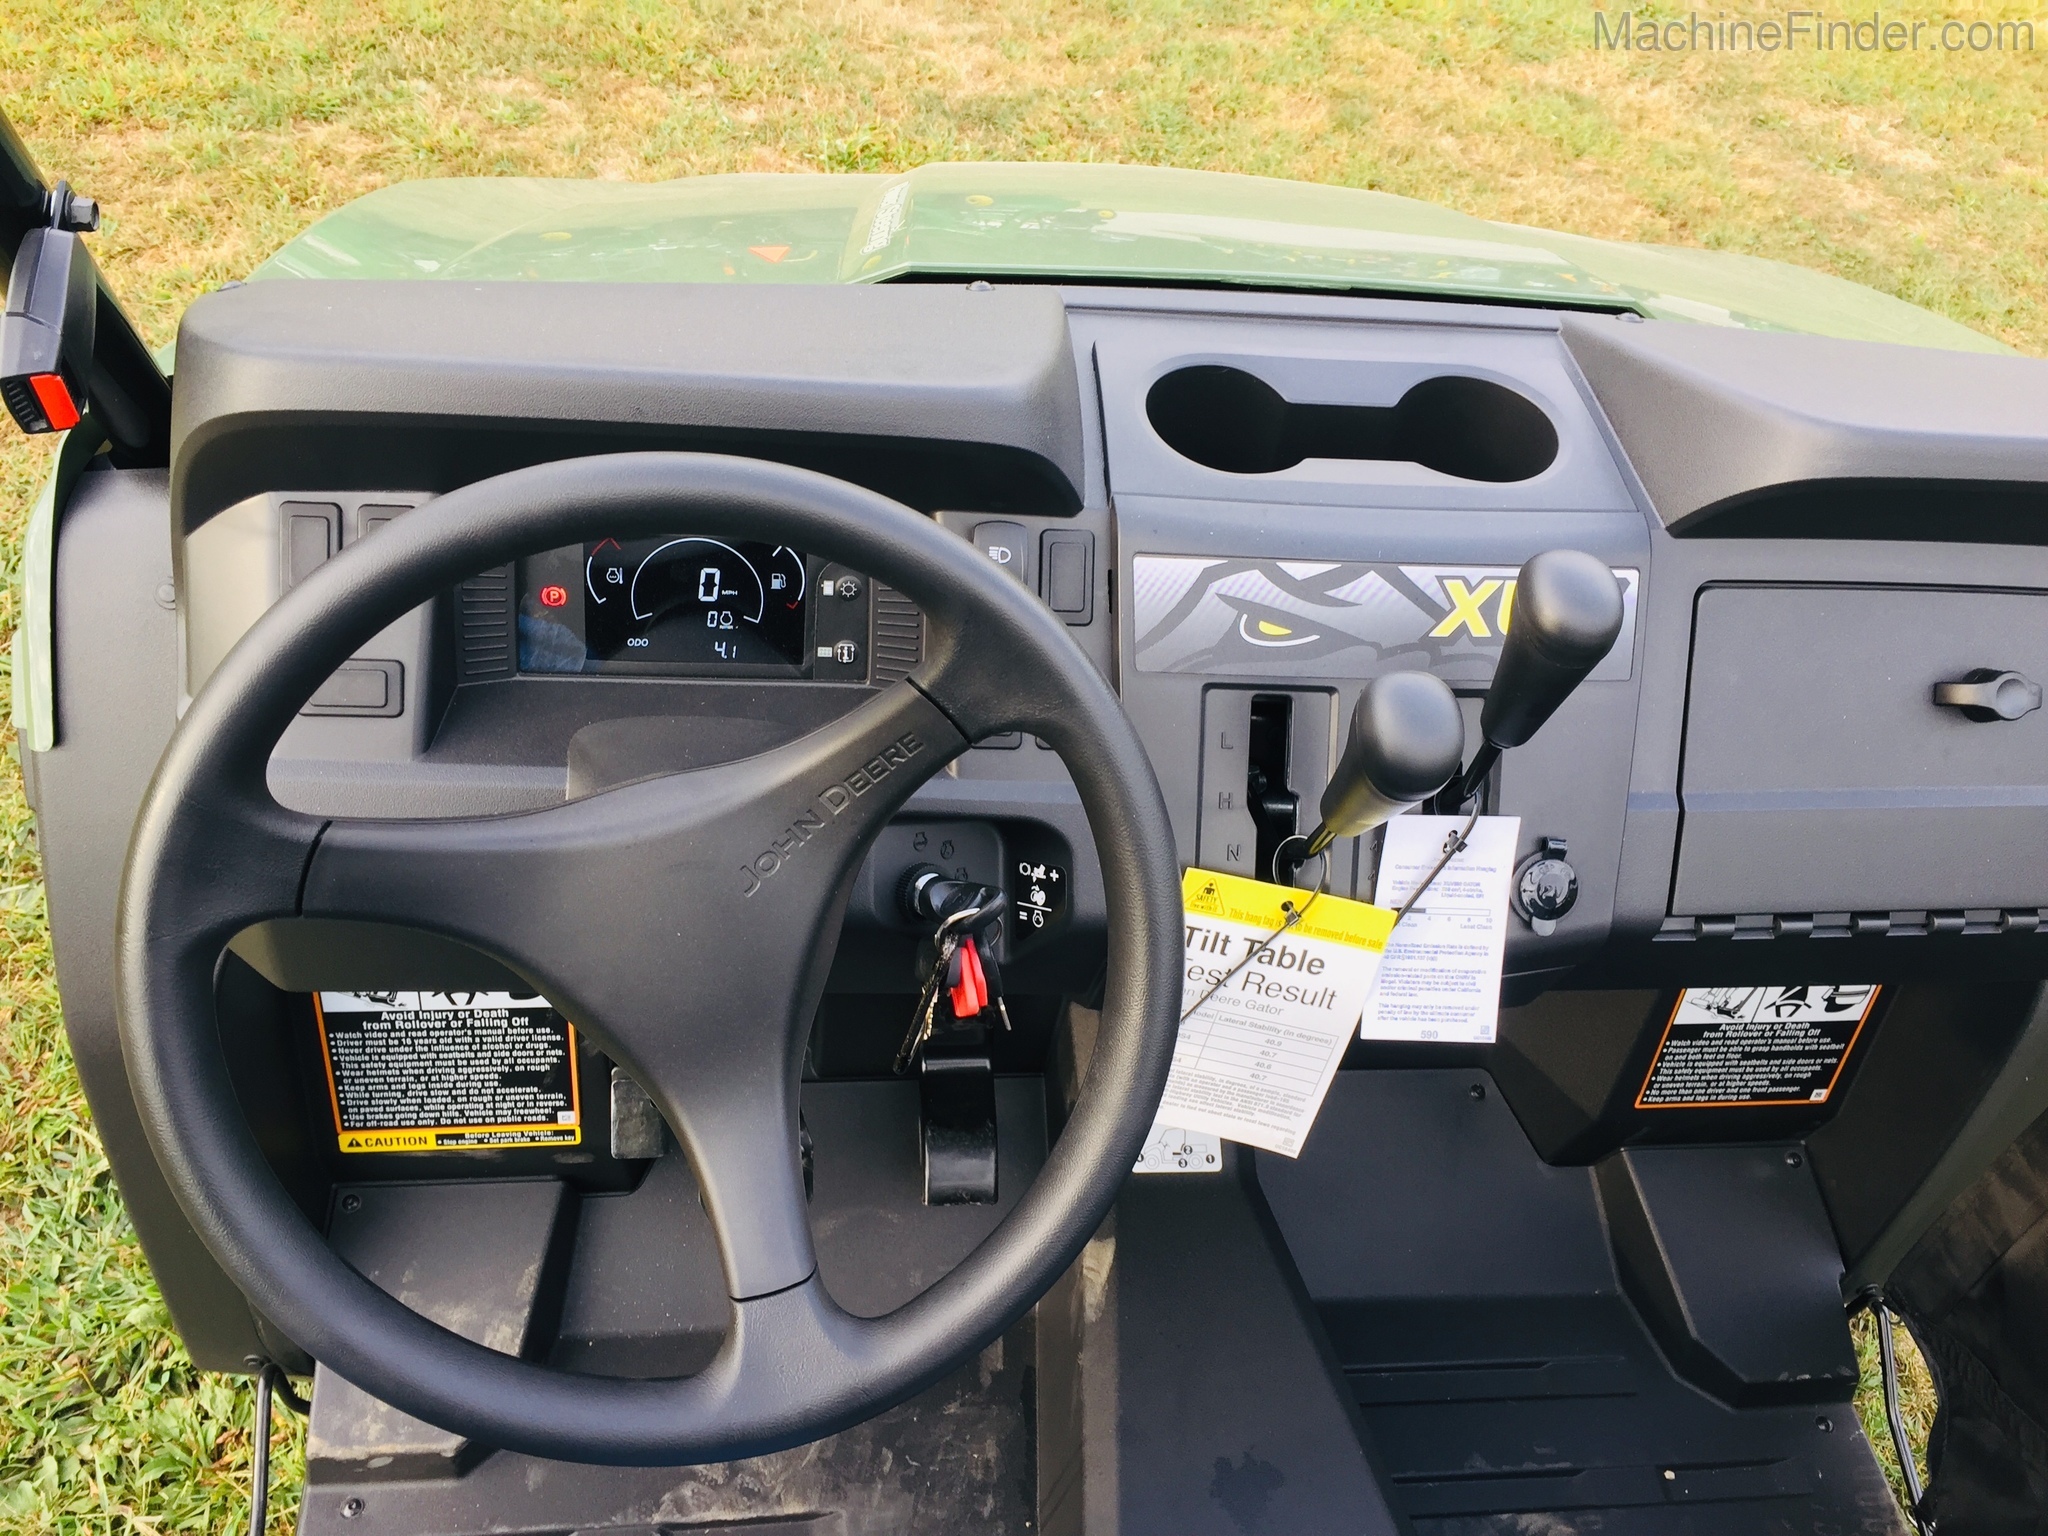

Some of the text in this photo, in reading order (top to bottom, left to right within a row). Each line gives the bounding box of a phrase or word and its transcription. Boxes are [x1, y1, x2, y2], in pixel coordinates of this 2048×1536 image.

[698, 567, 721, 602] 0
[706, 610, 718, 628] 0
[627, 638, 649, 647] ODO
[1220, 731, 1234, 750] L
[1218, 792, 1233, 810] H
[739, 731, 926, 899] JOHN DEERE
[1226, 844, 1241, 862] N
[1195, 893, 1217, 904] SAFETY
[1228, 907, 1245, 920] This
[1243, 911, 1263, 925] hang
[1261, 914, 1275, 928] tag
[1275, 918, 1283, 927] is
[1303, 922, 1313, 933] be
[1312, 924, 1344, 940] removed
[1343, 931, 1368, 945] before
[1366, 937, 1384, 949] sale
[1185, 925, 1325, 976] Tilt Table
[1186, 957, 1338, 1008] est Result
[1245, 998, 1285, 1016] Gator
[380, 1010, 415, 1020] Avoid
[418, 1010, 454, 1020] Injury
[473, 1008, 508, 1017] Death
[362, 1020, 391, 1029] from
[394, 1019, 446, 1028] Rollover
[466, 1017, 508, 1028] Falling
[511, 1017, 528, 1025] Off
[1718, 1023, 1745, 1031] Avoid
[1744, 1022, 1772, 1031] Injury
[335, 1031, 362, 1039] Watch
[364, 1030, 388, 1038] video
[429, 1028, 472, 1038] operator's
[506, 1027, 534, 1035] before
[1217, 1014, 1247, 1027] Lateral
[1247, 1020, 1282, 1035] Stability
[1282, 1028, 1295, 1038] (in
[1294, 1031, 1333, 1047] degrees)
[1420, 1030, 1438, 1038] 590
[1701, 1030, 1724, 1038] from
[1724, 1029, 1763, 1037] Rollover
[1773, 1028, 1806, 1037] Falling
[1806, 1028, 1821, 1036] Off
[364, 1038, 386, 1046] must
[413, 1038, 437, 1046] years
[438, 1036, 452, 1044] old
[1263, 1037, 1283, 1047] 40.9
[337, 1046, 362, 1054] Never
[414, 1044, 428, 1052] the
[481, 1042, 512, 1050] alcohol
[525, 1041, 550, 1050] drugs.
[1258, 1048, 1277, 1059] 40.7
[380, 1052, 418, 1061] equipped
[476, 1050, 492, 1058] and
[511, 1049, 534, 1057] doors
[360, 1060, 386, 1069] safety
[387, 1059, 432, 1068] equipment
[491, 1058, 501, 1066] by
[516, 1056, 559, 1065] occupants.
[1254, 1060, 1273, 1070] 40.6
[1248, 1071, 1267, 1082] 40.7
[491, 1130, 520, 1138] Leaving
[364, 1136, 428, 1147] CAUTION
